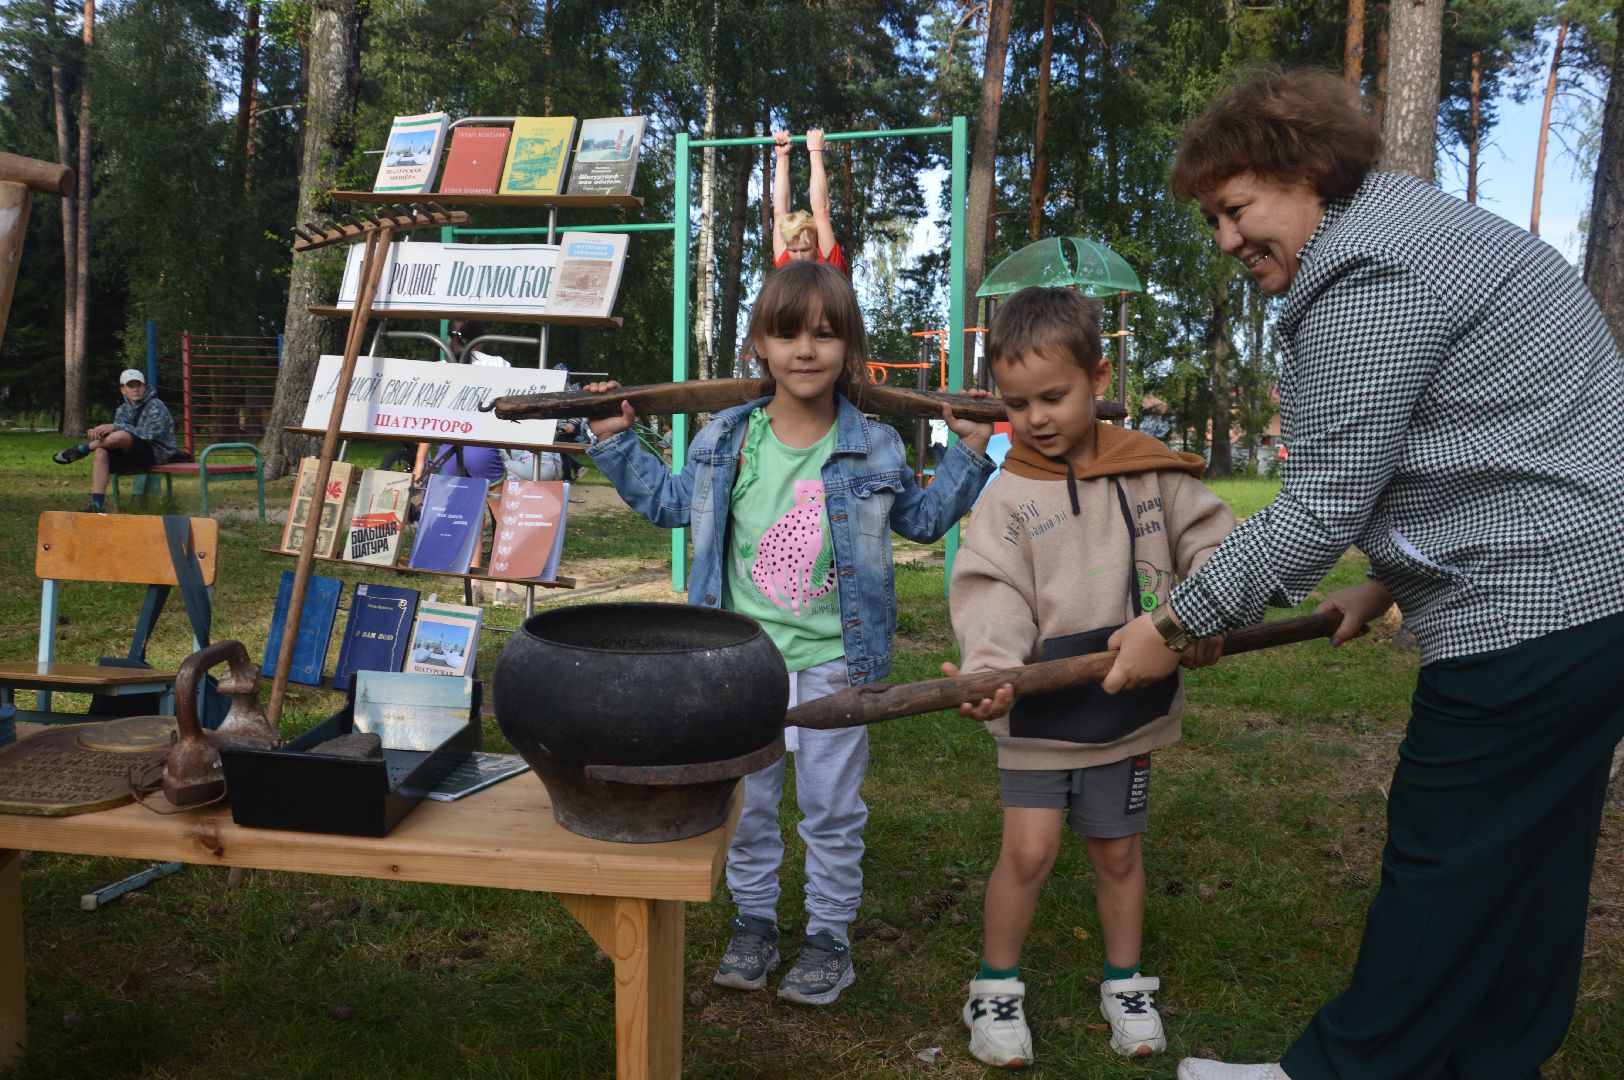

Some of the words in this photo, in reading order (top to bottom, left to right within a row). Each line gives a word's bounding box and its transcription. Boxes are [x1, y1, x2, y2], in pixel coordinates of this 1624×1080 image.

[388, 262, 441, 297] РОДНОЕ
[374, 413, 473, 434] ШАТУРТОРФ
[1136, 496, 1163, 519] play
[351, 521, 397, 545] БОЛЬШАЯ
[351, 537, 389, 559] ШАТУРА
